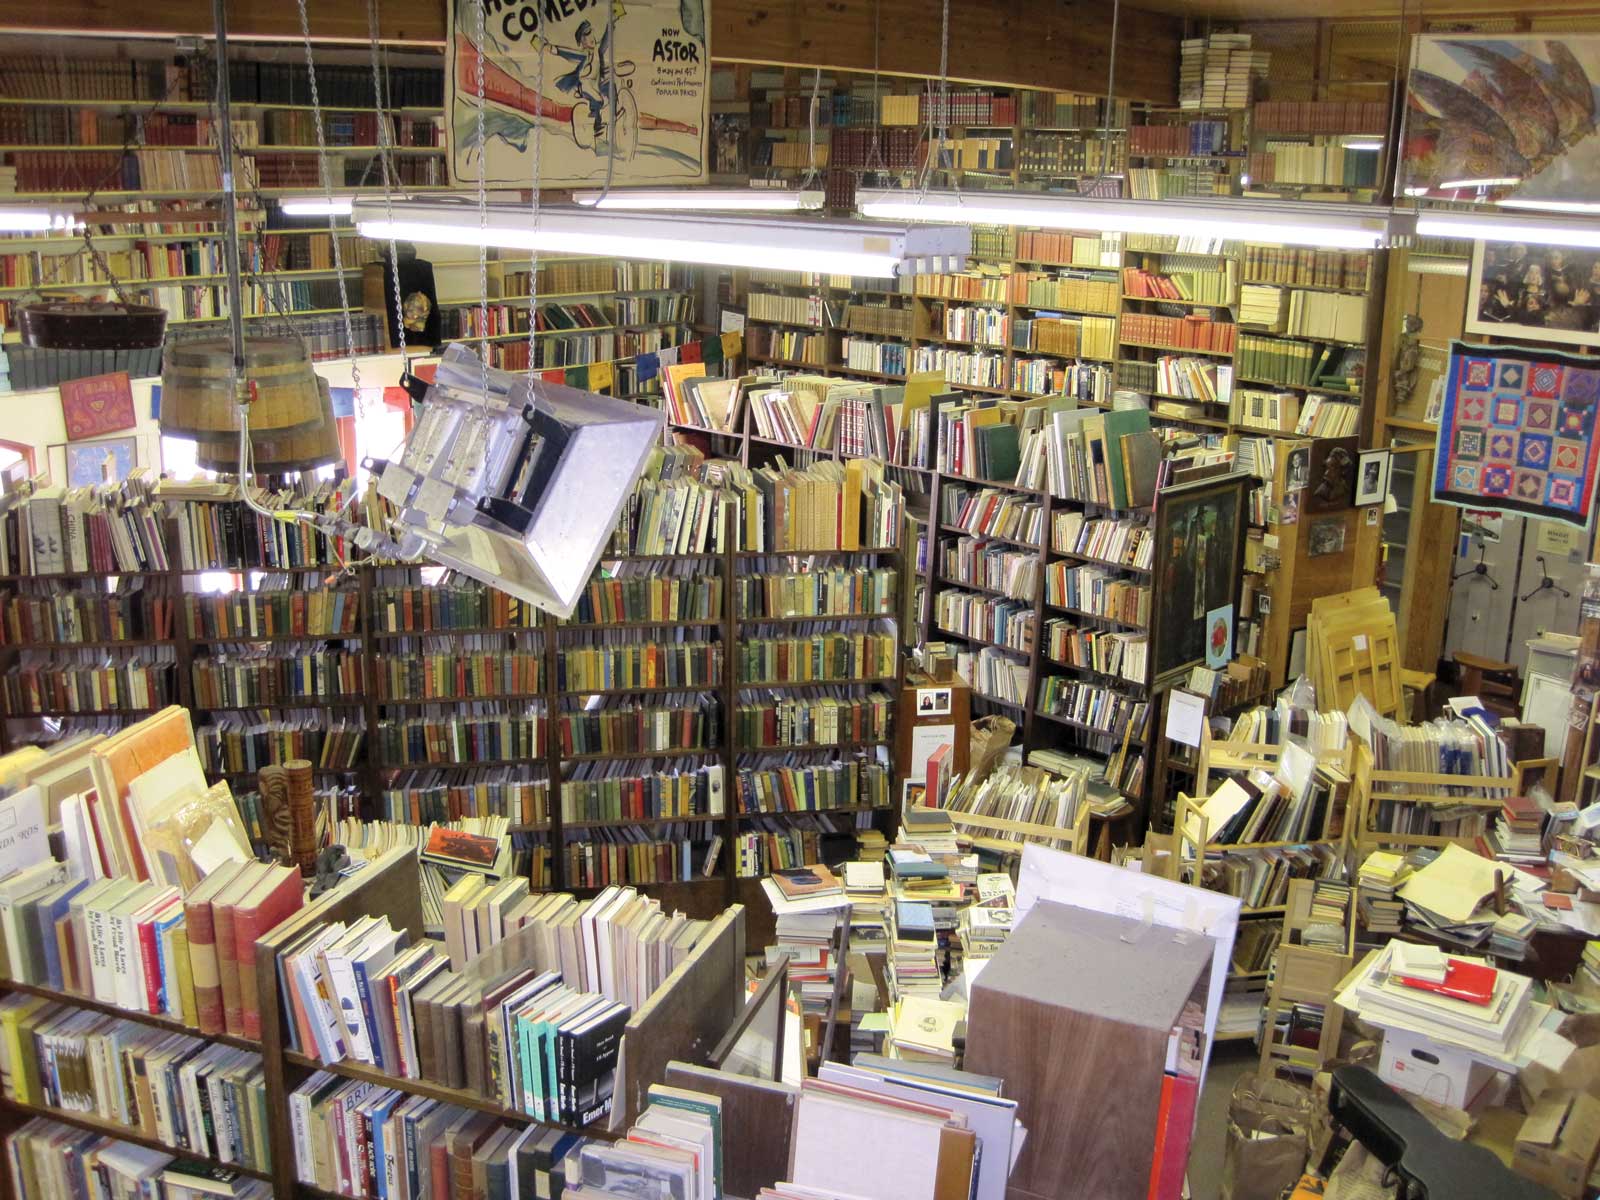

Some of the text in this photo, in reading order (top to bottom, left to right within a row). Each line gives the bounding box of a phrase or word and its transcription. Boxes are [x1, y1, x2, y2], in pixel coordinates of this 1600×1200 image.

[503, 0, 597, 41] COMED
[662, 28, 680, 37] NOW
[652, 38, 699, 64] ASTOR
[68, 513, 78, 543] CHINA
[346, 1082, 376, 1112] BRIA
[582, 1105, 604, 1125] Emer
